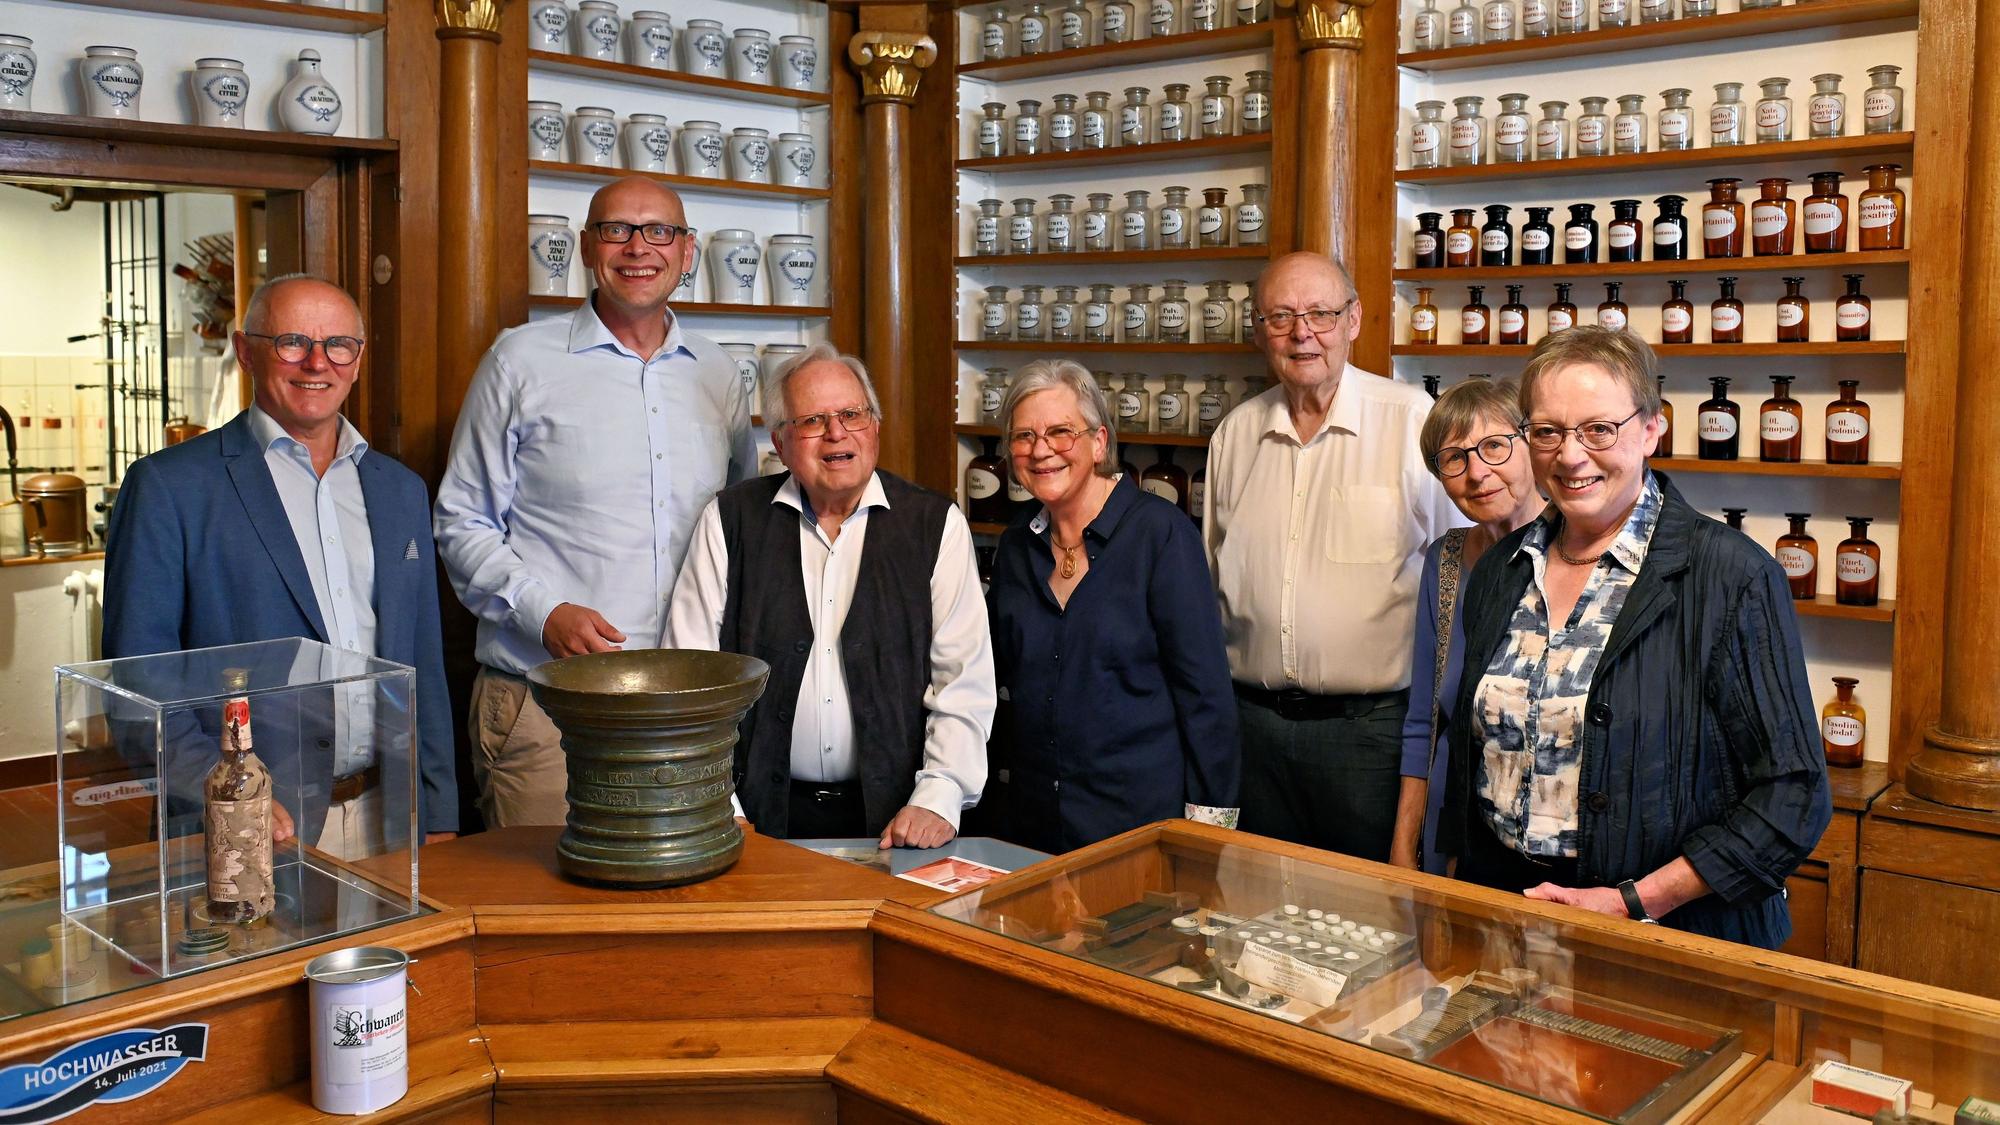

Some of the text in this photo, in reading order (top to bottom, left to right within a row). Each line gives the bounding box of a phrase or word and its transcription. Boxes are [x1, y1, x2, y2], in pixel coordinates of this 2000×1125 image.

[11, 61, 26, 70] KAL
[548, 239, 568, 248] PASTA
[1840, 557, 1864, 567] Tinct.
[24, 1034, 178, 1091] HOCHWASSER
[94, 1060, 168, 1091] 14. Juli 2021
